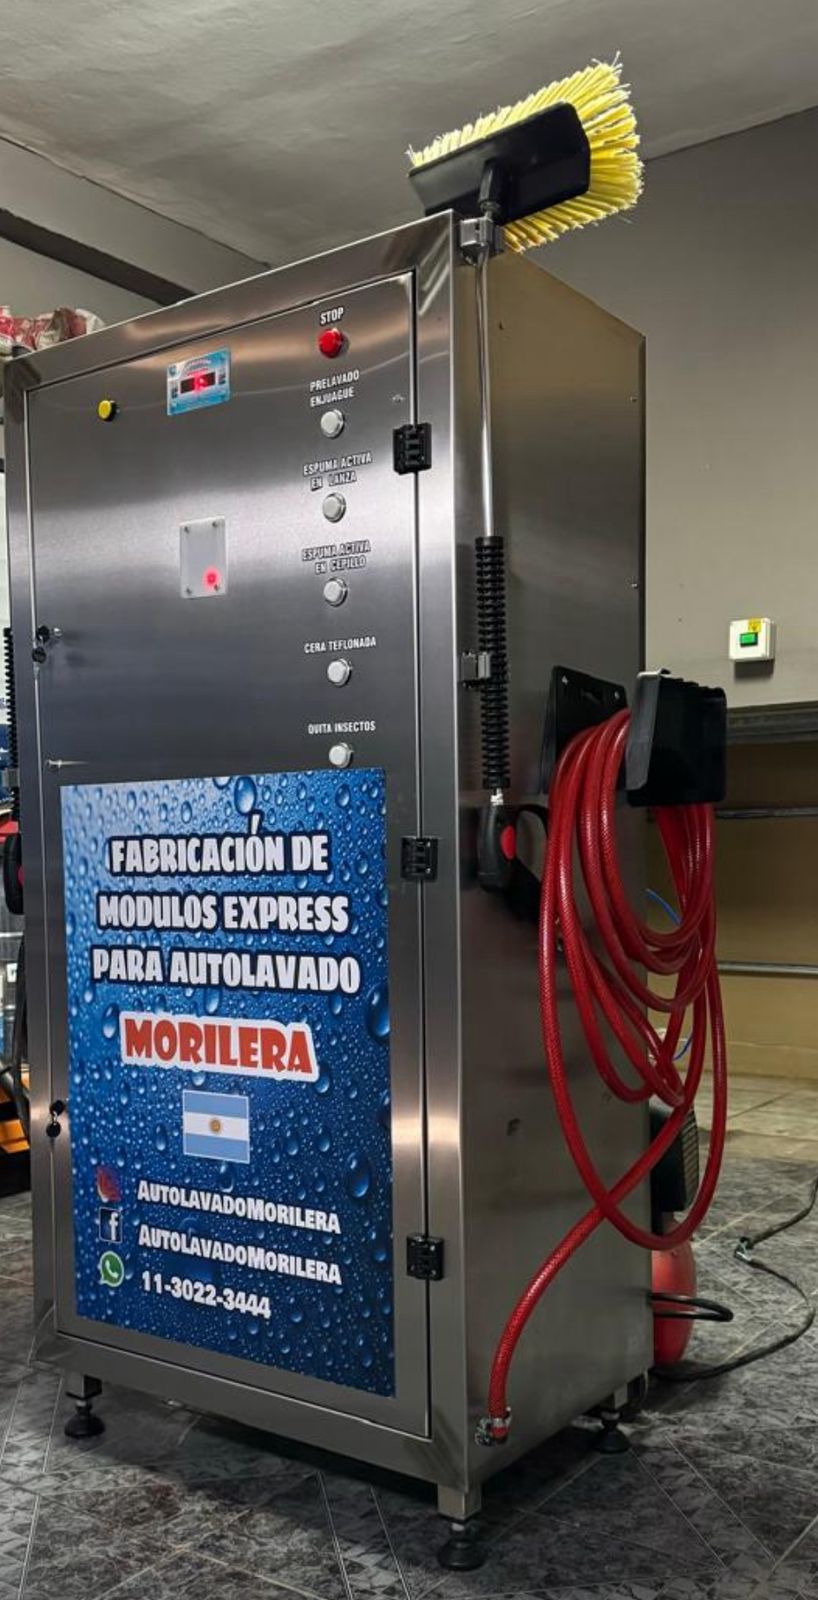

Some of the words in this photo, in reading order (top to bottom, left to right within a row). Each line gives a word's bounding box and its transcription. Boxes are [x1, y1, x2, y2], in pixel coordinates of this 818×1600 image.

[320, 307, 344, 325] STOP
[309, 369, 360, 392] PRELAVADO
[310, 386, 355, 407] ENJUAGUE
[303, 458, 338, 476] ESPUMA
[341, 451, 373, 469] ACTIVA
[311, 477, 323, 491] EN
[328, 470, 357, 487] LANZA
[302, 545, 337, 561] ESPUMA
[340, 539, 371, 556] ACTIVA
[315, 561, 327, 575] EN
[329, 555, 367, 572] CEPILLO
[304, 642, 327, 653] CERA
[328, 636, 377, 651] TEFLONADA
[308, 723, 332, 734] QUITA
[334, 720, 376, 732] INSECTOS
[111, 814, 285, 874] FABRICACIÓN
[291, 835, 329, 872] DE
[99, 894, 218, 930] MODULOS
[223, 894, 349, 932] EXPRESS
[93, 949, 164, 983] PARA
[170, 951, 361, 994] AUTOLAVADO
[124, 1018, 313, 1074] MORILERA
[141, 1270, 272, 1319] 11-3022-3444
